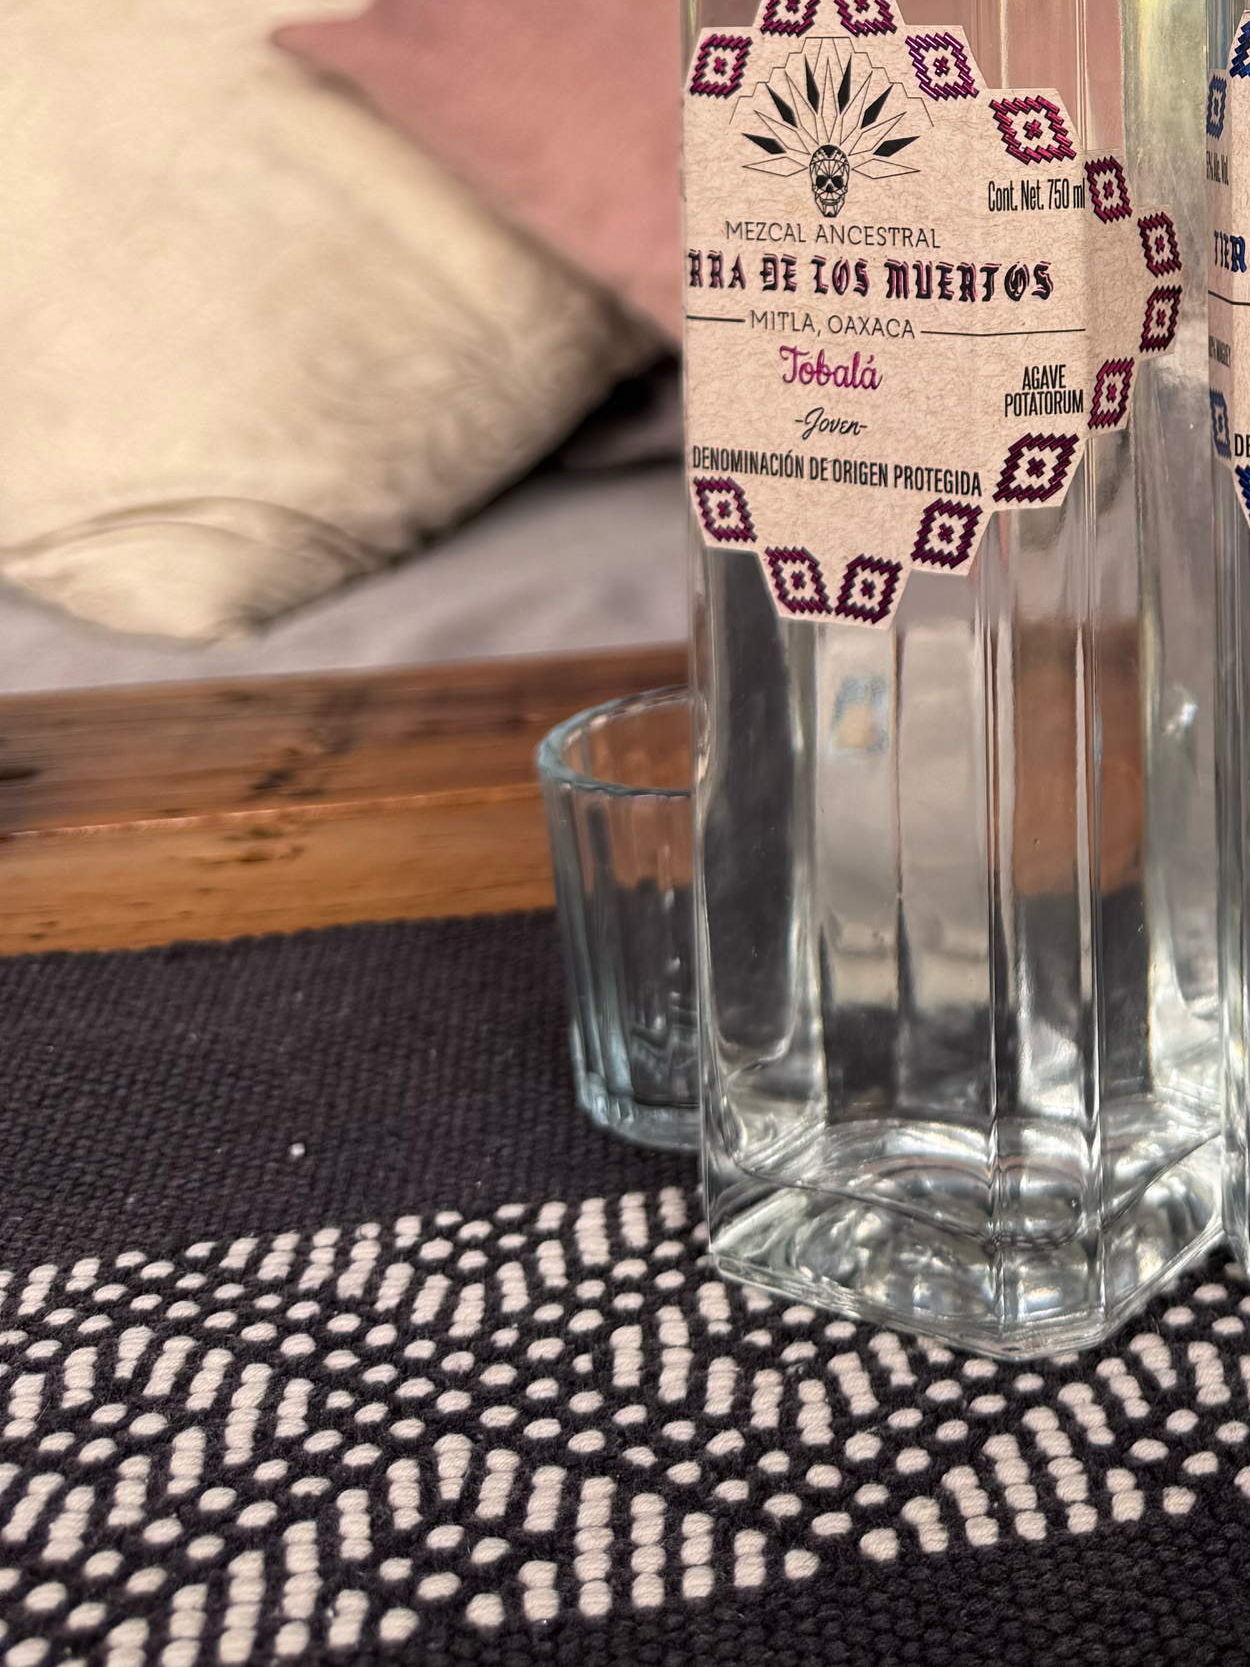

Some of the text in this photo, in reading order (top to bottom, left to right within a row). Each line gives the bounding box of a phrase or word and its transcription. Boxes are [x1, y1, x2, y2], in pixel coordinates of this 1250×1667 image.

[988, 177, 1086, 212] Cont. Net. 750 ml
[725, 221, 941, 249] MEZCAL ANCESTRAL
[760, 253, 798, 293] DE
[811, 255, 870, 297] LOS
[884, 258, 1054, 303] MUERTOS
[750, 310, 916, 339] MITLA, OAXACA
[779, 345, 883, 390] Tobalá
[1022, 364, 1066, 391] AGAVE
[1005, 389, 1084, 418] POTATORUM
[693, 445, 982, 497] DENOMINACIÓN DE ORIGEN PROTEGIDA
